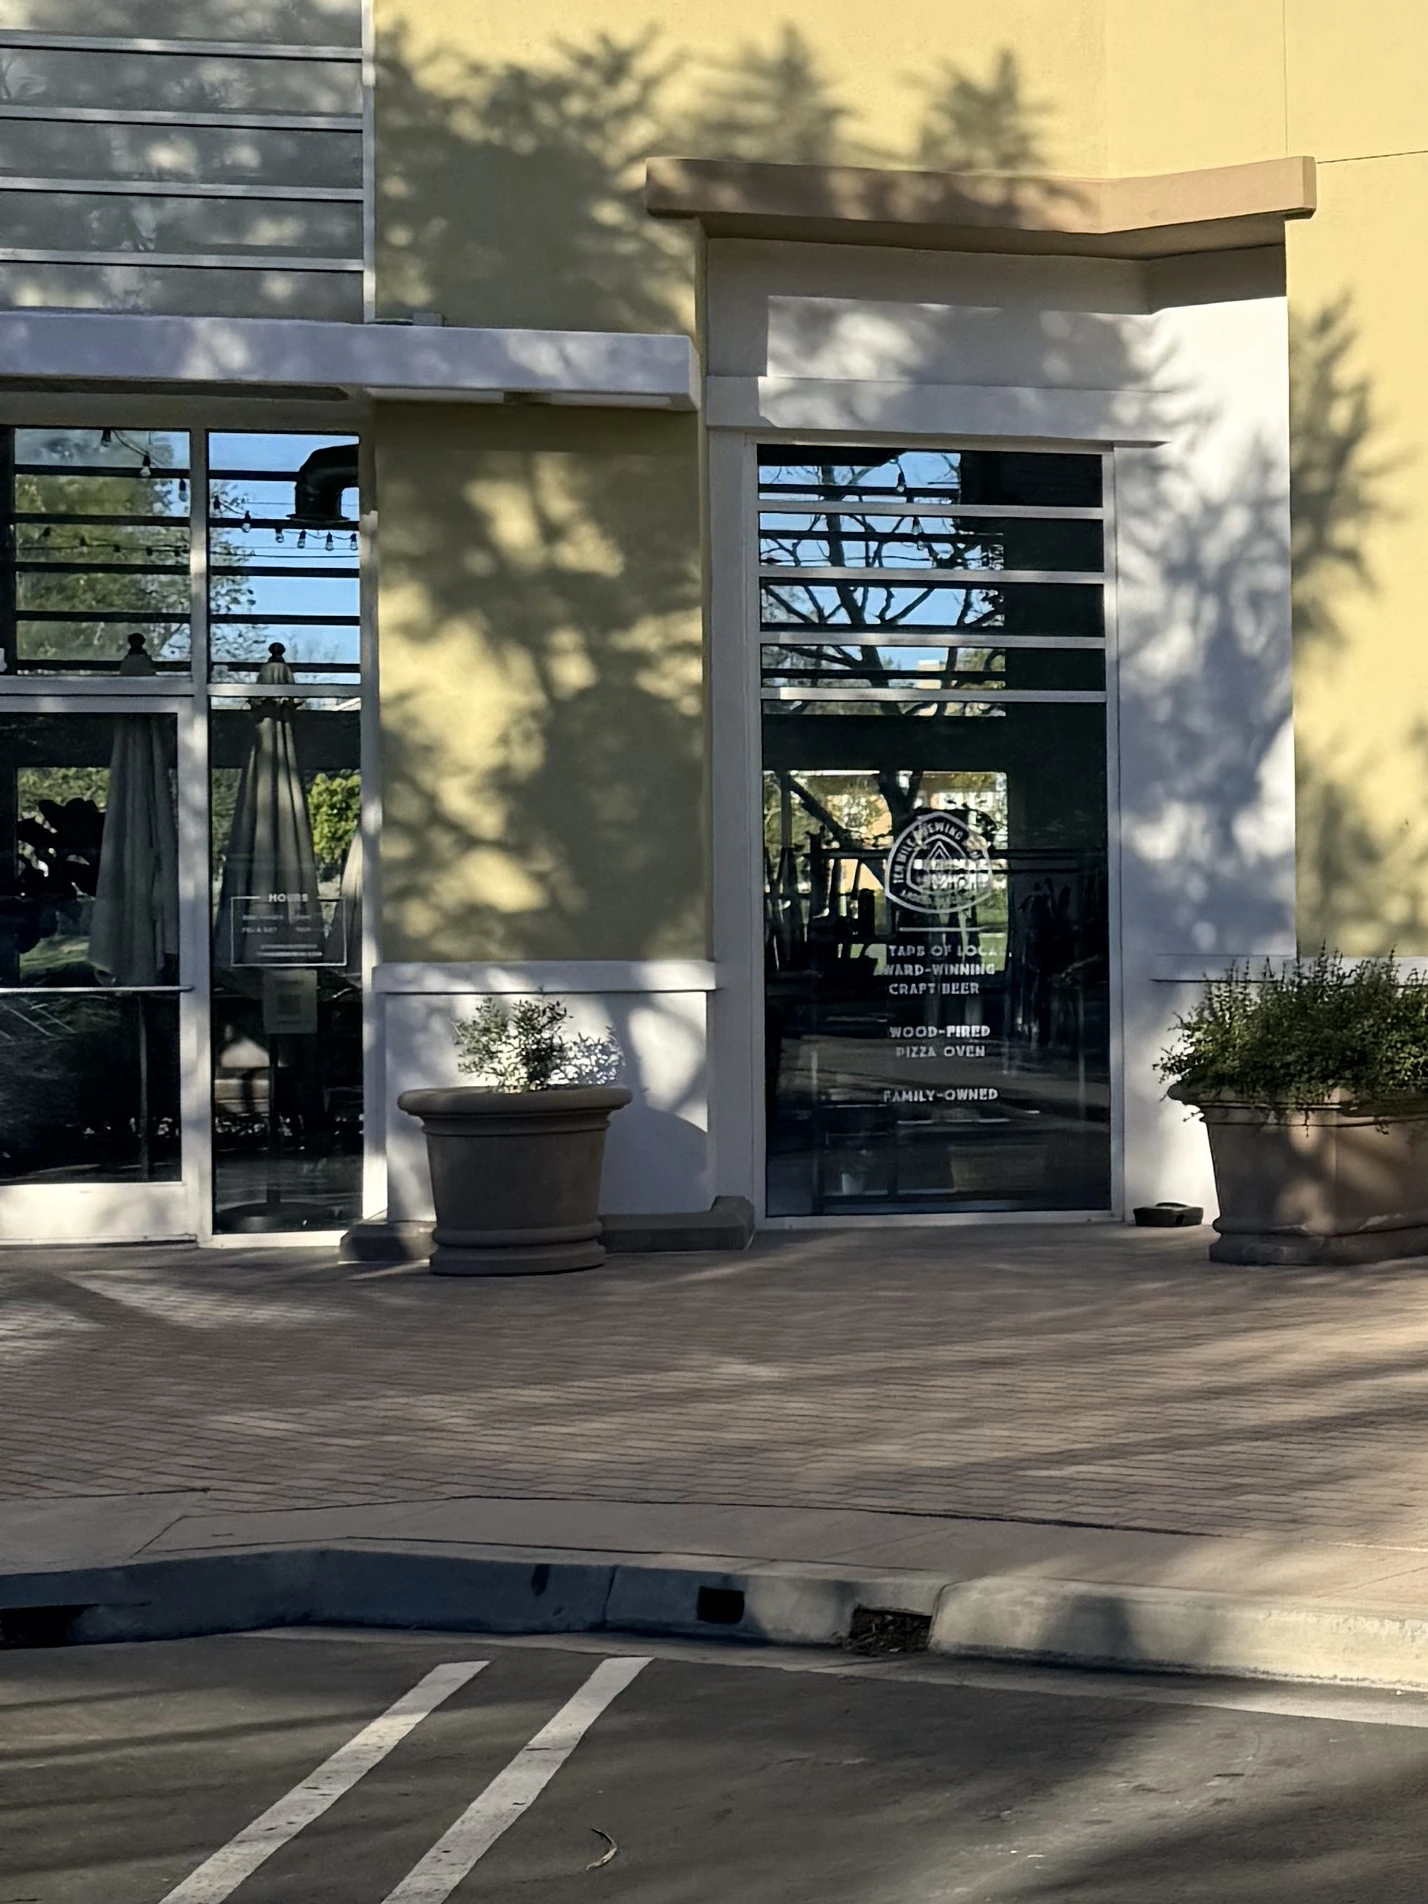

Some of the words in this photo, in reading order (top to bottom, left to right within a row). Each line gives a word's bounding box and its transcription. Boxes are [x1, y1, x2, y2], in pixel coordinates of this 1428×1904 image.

[888, 945, 925, 956] TAPS
[931, 945, 952, 957] OF
[957, 945, 1003, 957] LOCA
[875, 963, 996, 976] WARD-WINNING
[888, 983, 936, 995] CRAFT
[941, 982, 980, 995] BEER
[889, 1025, 991, 1038] WOOD-FIRED
[896, 1046, 937, 1058] PIZZA
[943, 1045, 985, 1057] OVEN
[883, 1088, 999, 1103] FAMILY-OWNED
